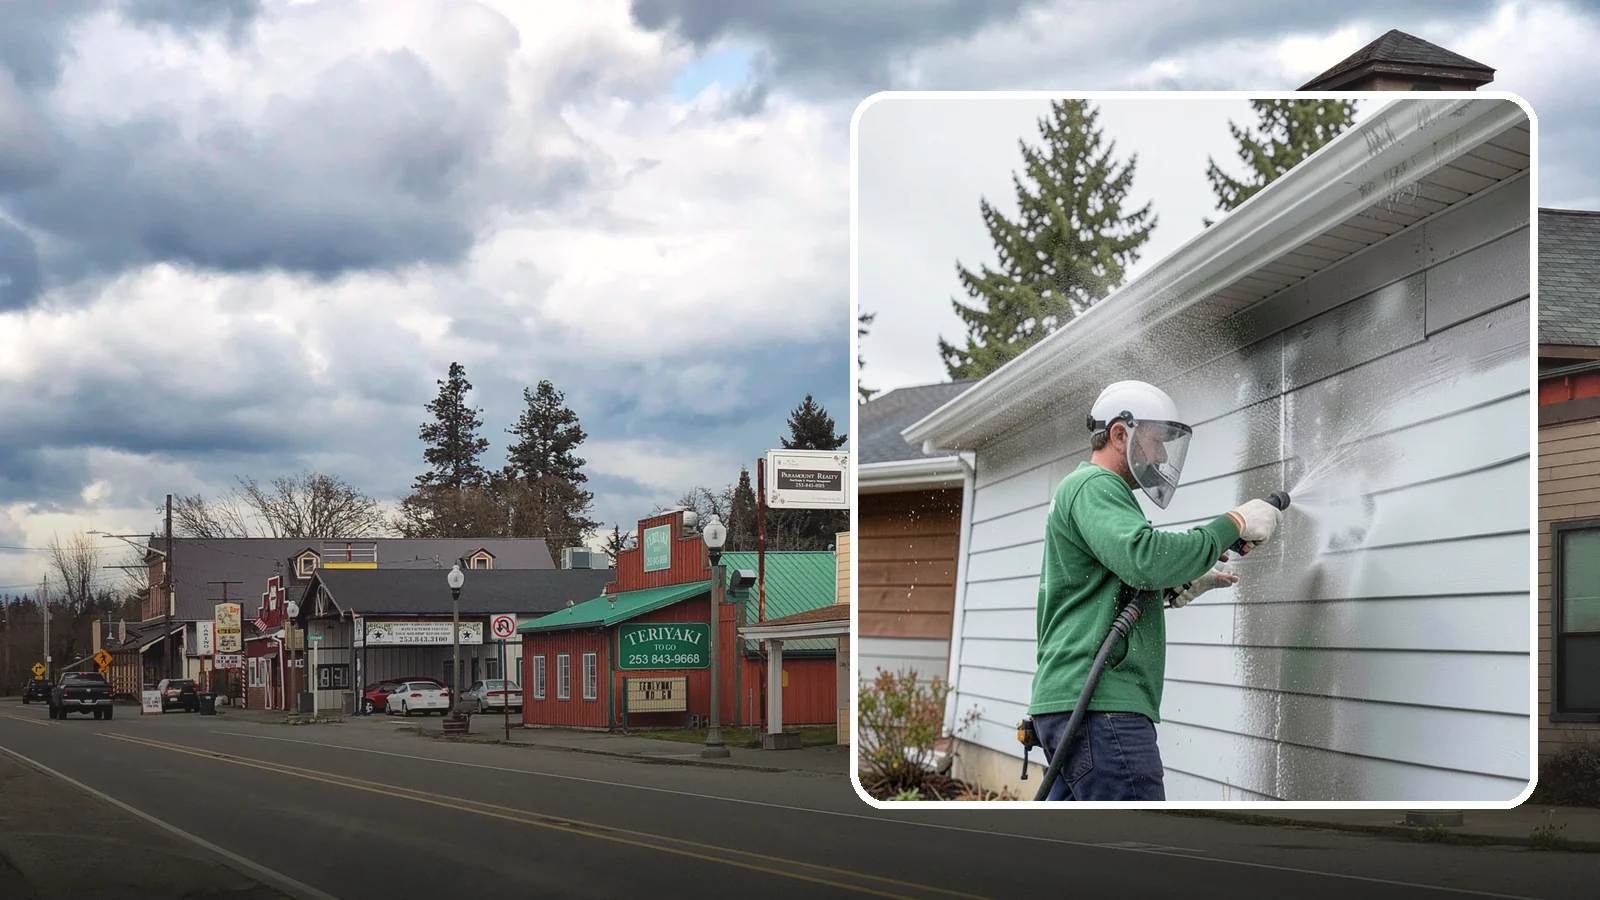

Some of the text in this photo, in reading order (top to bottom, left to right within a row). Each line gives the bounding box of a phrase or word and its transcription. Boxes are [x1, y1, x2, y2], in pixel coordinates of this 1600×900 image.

[625, 627, 703, 646] TERIYAKI
[629, 653, 700, 665] 253 843-9668
